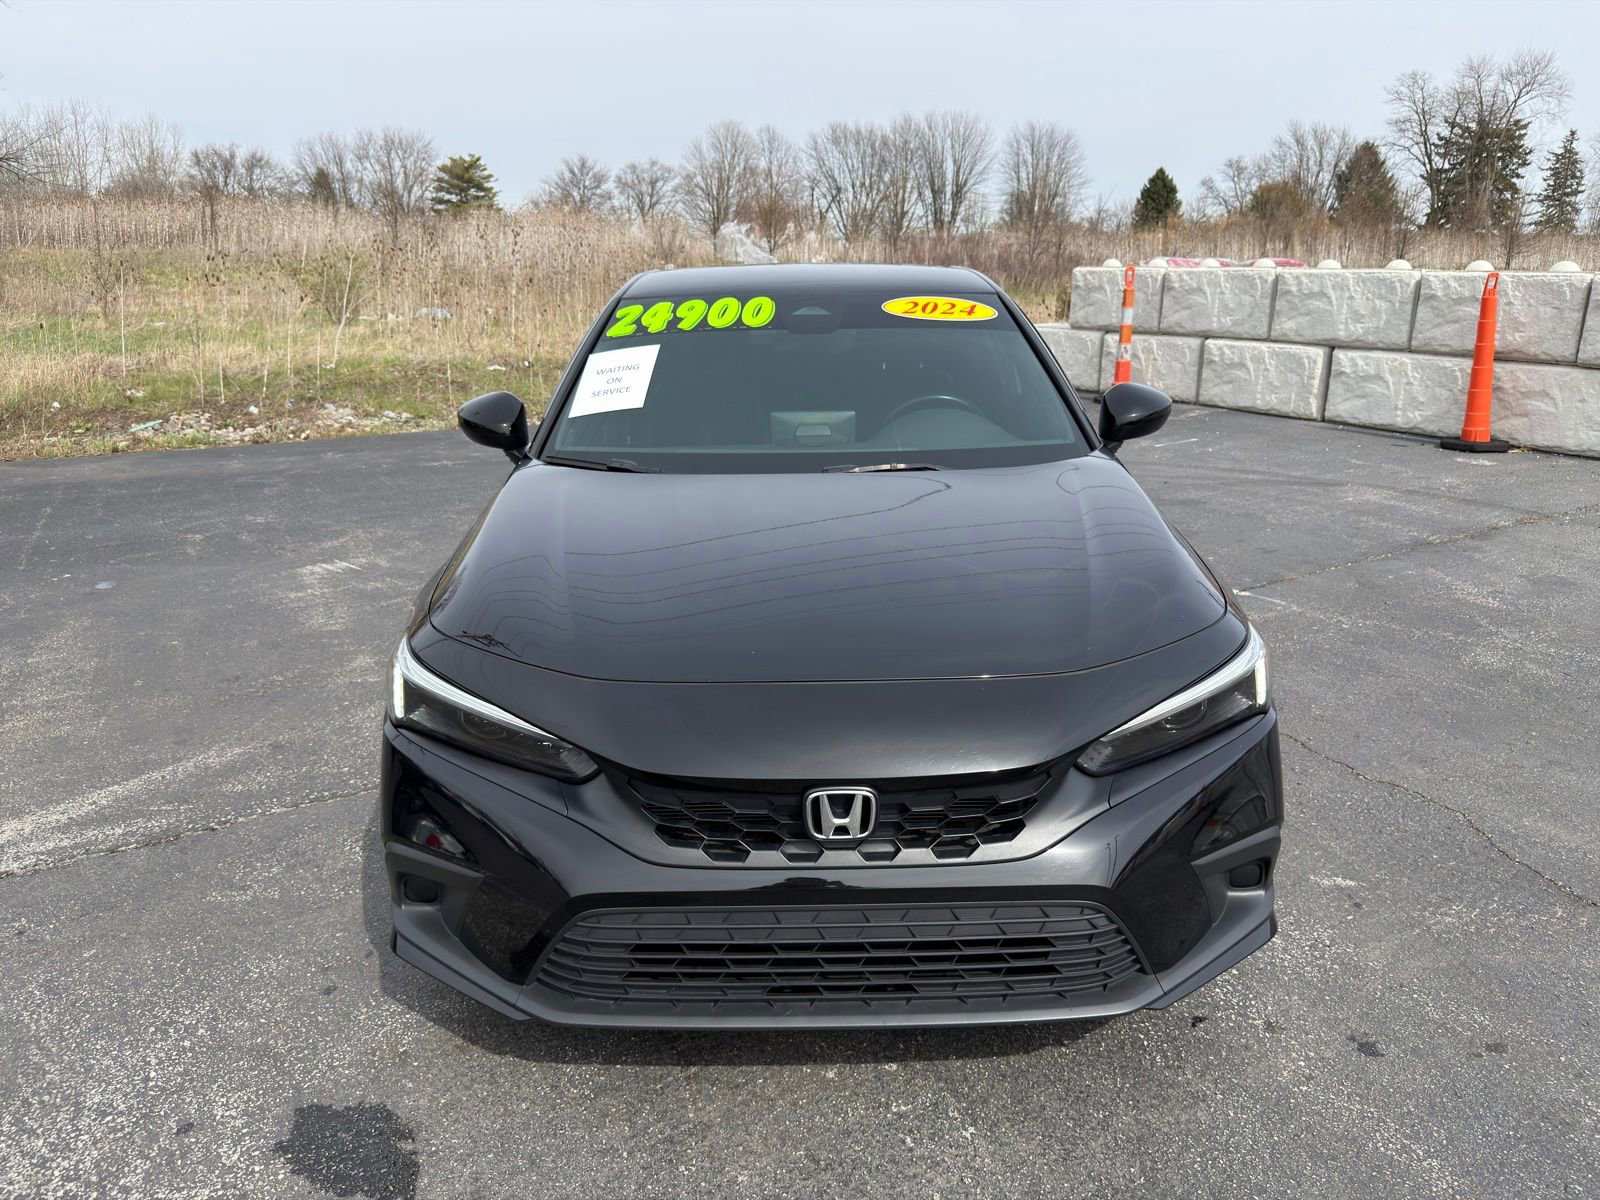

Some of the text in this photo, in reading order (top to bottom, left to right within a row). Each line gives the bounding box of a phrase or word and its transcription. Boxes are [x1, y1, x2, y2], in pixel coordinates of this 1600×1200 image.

[903, 301, 977, 316] 2024
[606, 296, 776, 337] 24900
[596, 363, 640, 376] WAITING
[606, 377, 623, 385] ON
[591, 386, 632, 398] SERVICE
